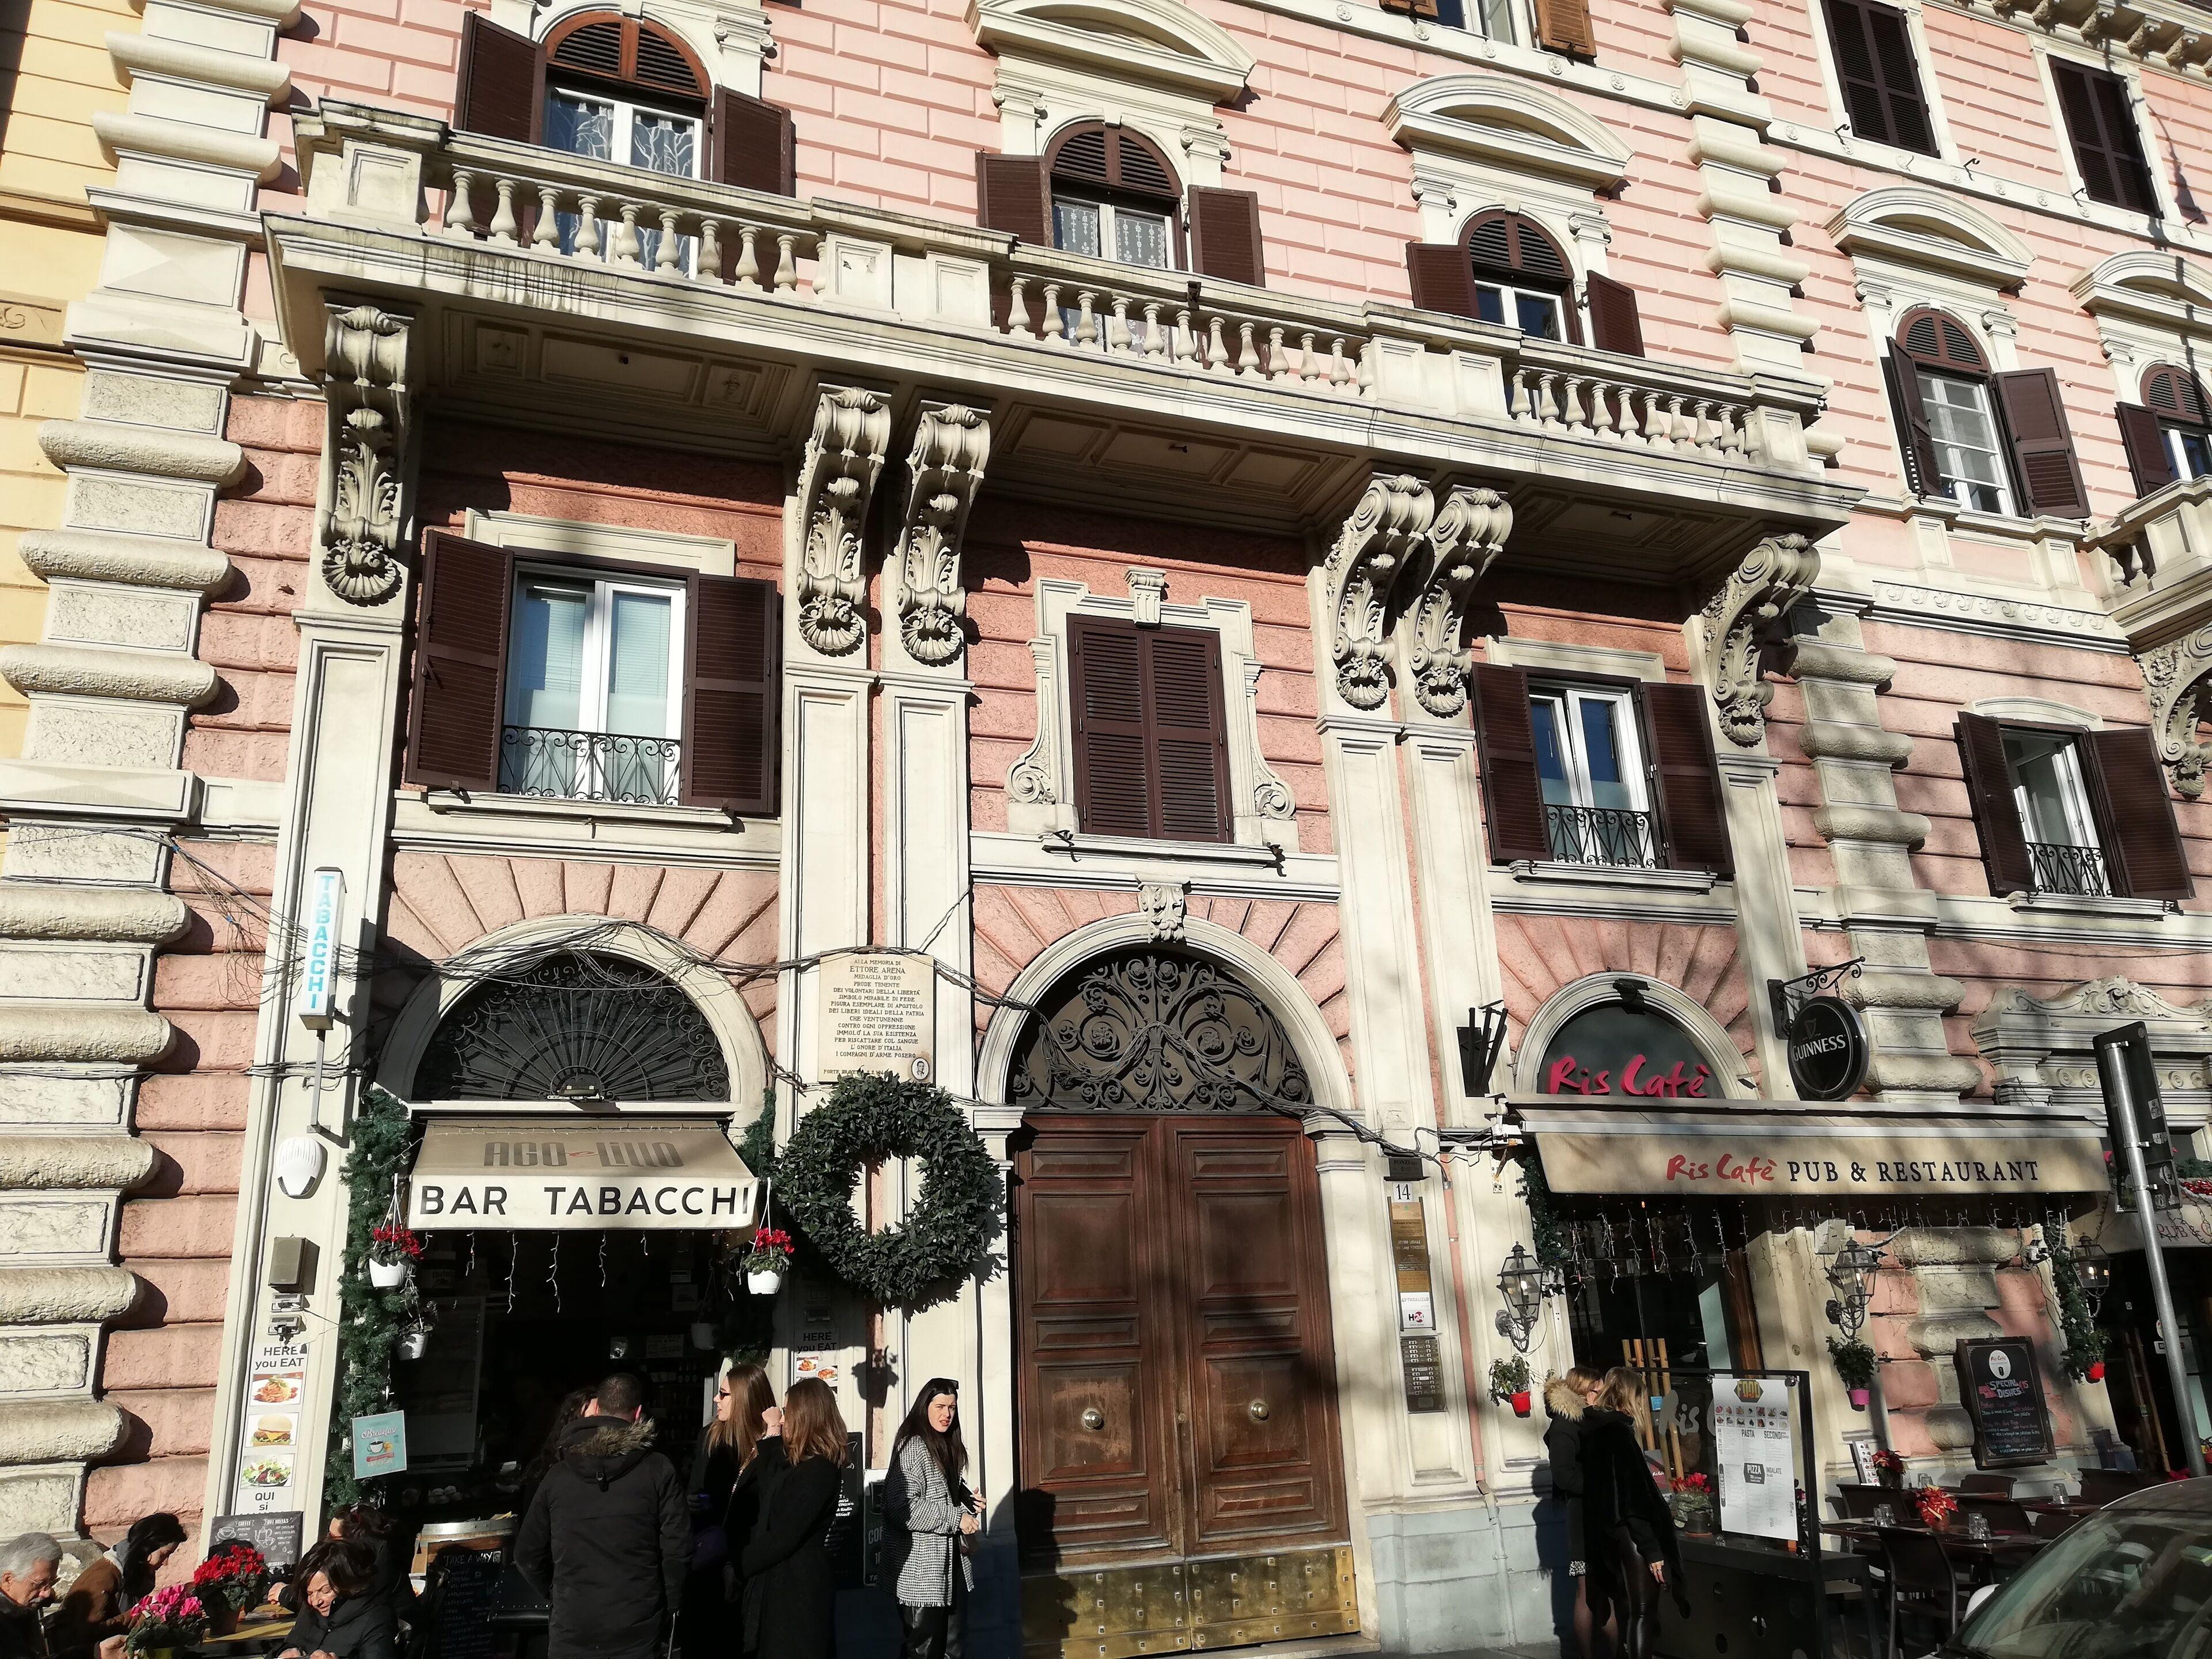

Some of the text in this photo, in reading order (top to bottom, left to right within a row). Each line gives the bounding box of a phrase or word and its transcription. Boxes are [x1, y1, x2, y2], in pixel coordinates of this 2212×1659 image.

[308, 876, 335, 1008] TABACCHI
[1792, 1035, 1846, 1062] GUINNESS
[1547, 1054, 1711, 1097] Ris Cafè
[483, 1142, 568, 1166] AGO
[1666, 1153, 2038, 1185] Ris Cafè PUB & RESTAURANT
[1396, 1184, 1410, 1200] 14
[421, 1187, 748, 1215] BAR TABACCHI
[803, 1332, 832, 1341] HERE
[263, 1346, 298, 1356] HERE
[797, 1342, 837, 1354] you EAT
[255, 1357, 305, 1370] you EAT
[1741, 1429, 1755, 1438] PASTA
[1747, 1464, 1762, 1474] PIZZA
[255, 1493, 274, 1501] QUI
[444, 1555, 465, 1566] TAKE
[476, 1552, 493, 1563] WAY
